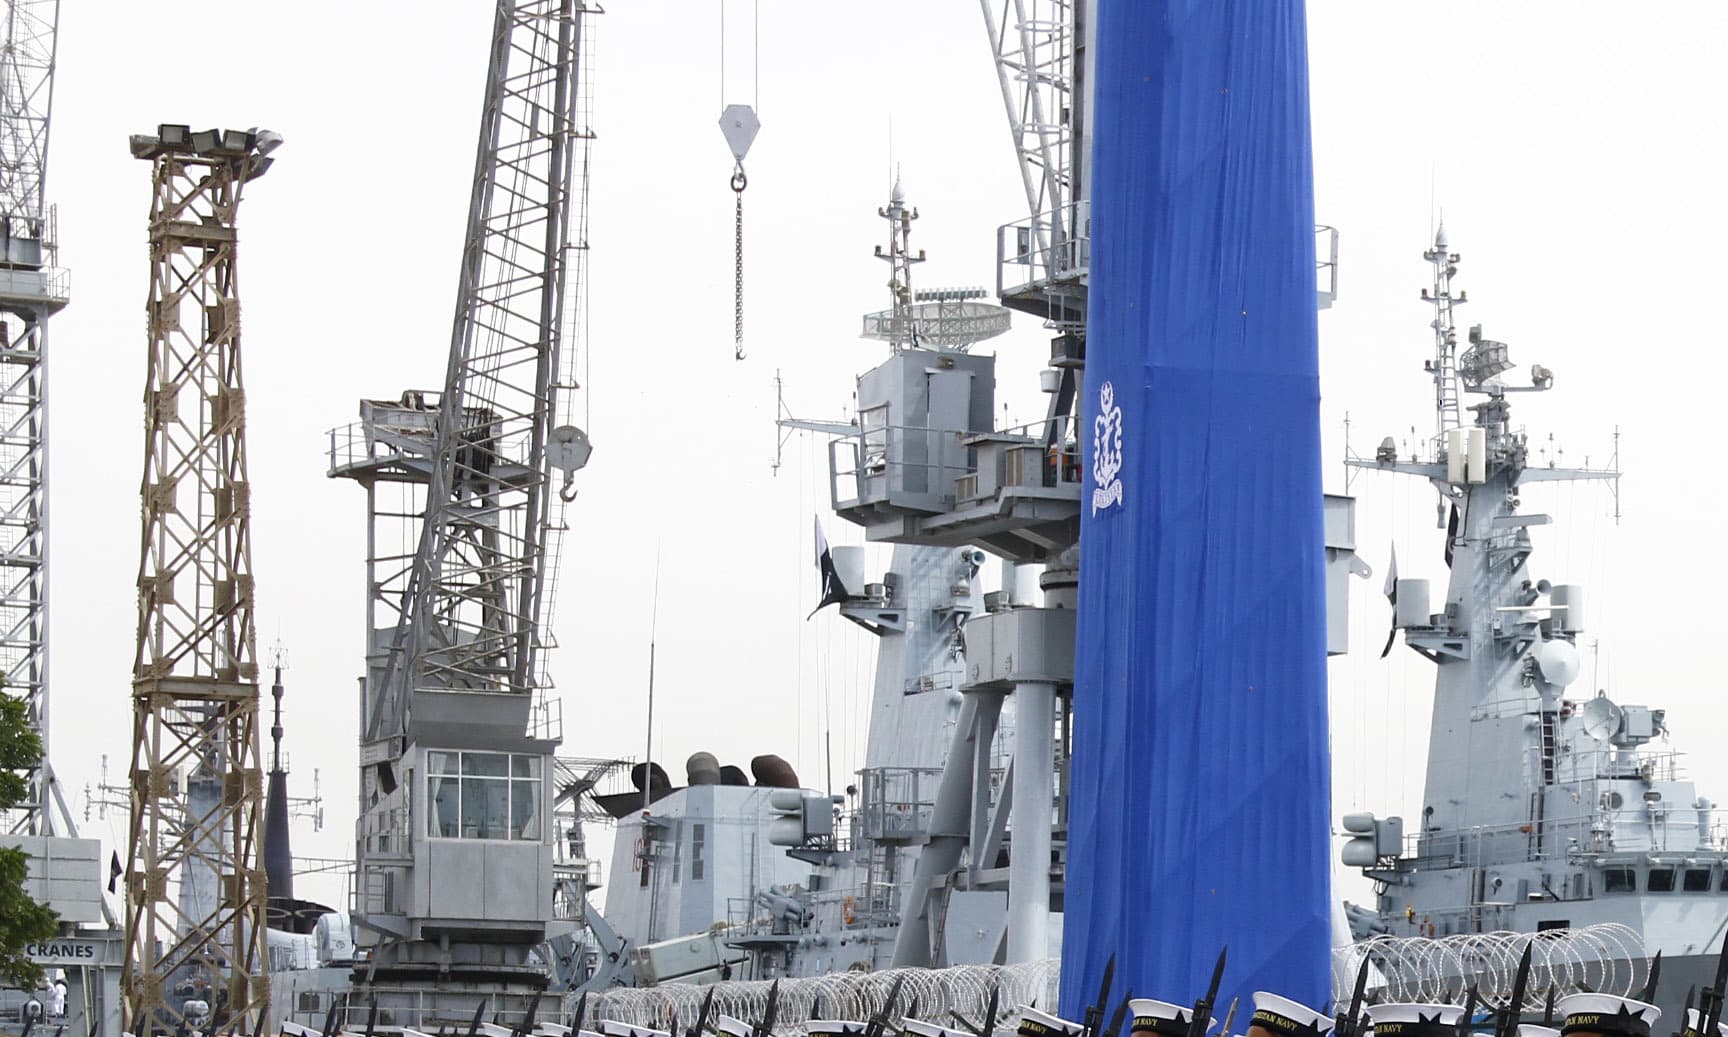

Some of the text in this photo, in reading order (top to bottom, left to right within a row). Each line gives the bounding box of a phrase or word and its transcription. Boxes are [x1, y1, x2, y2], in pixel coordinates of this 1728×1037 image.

[26, 944, 94, 958] CRANES
[1276, 1017, 1298, 1031] NAVY
[1577, 1015, 1600, 1024] NAVY
[1383, 1024, 1402, 1033] NAVY
